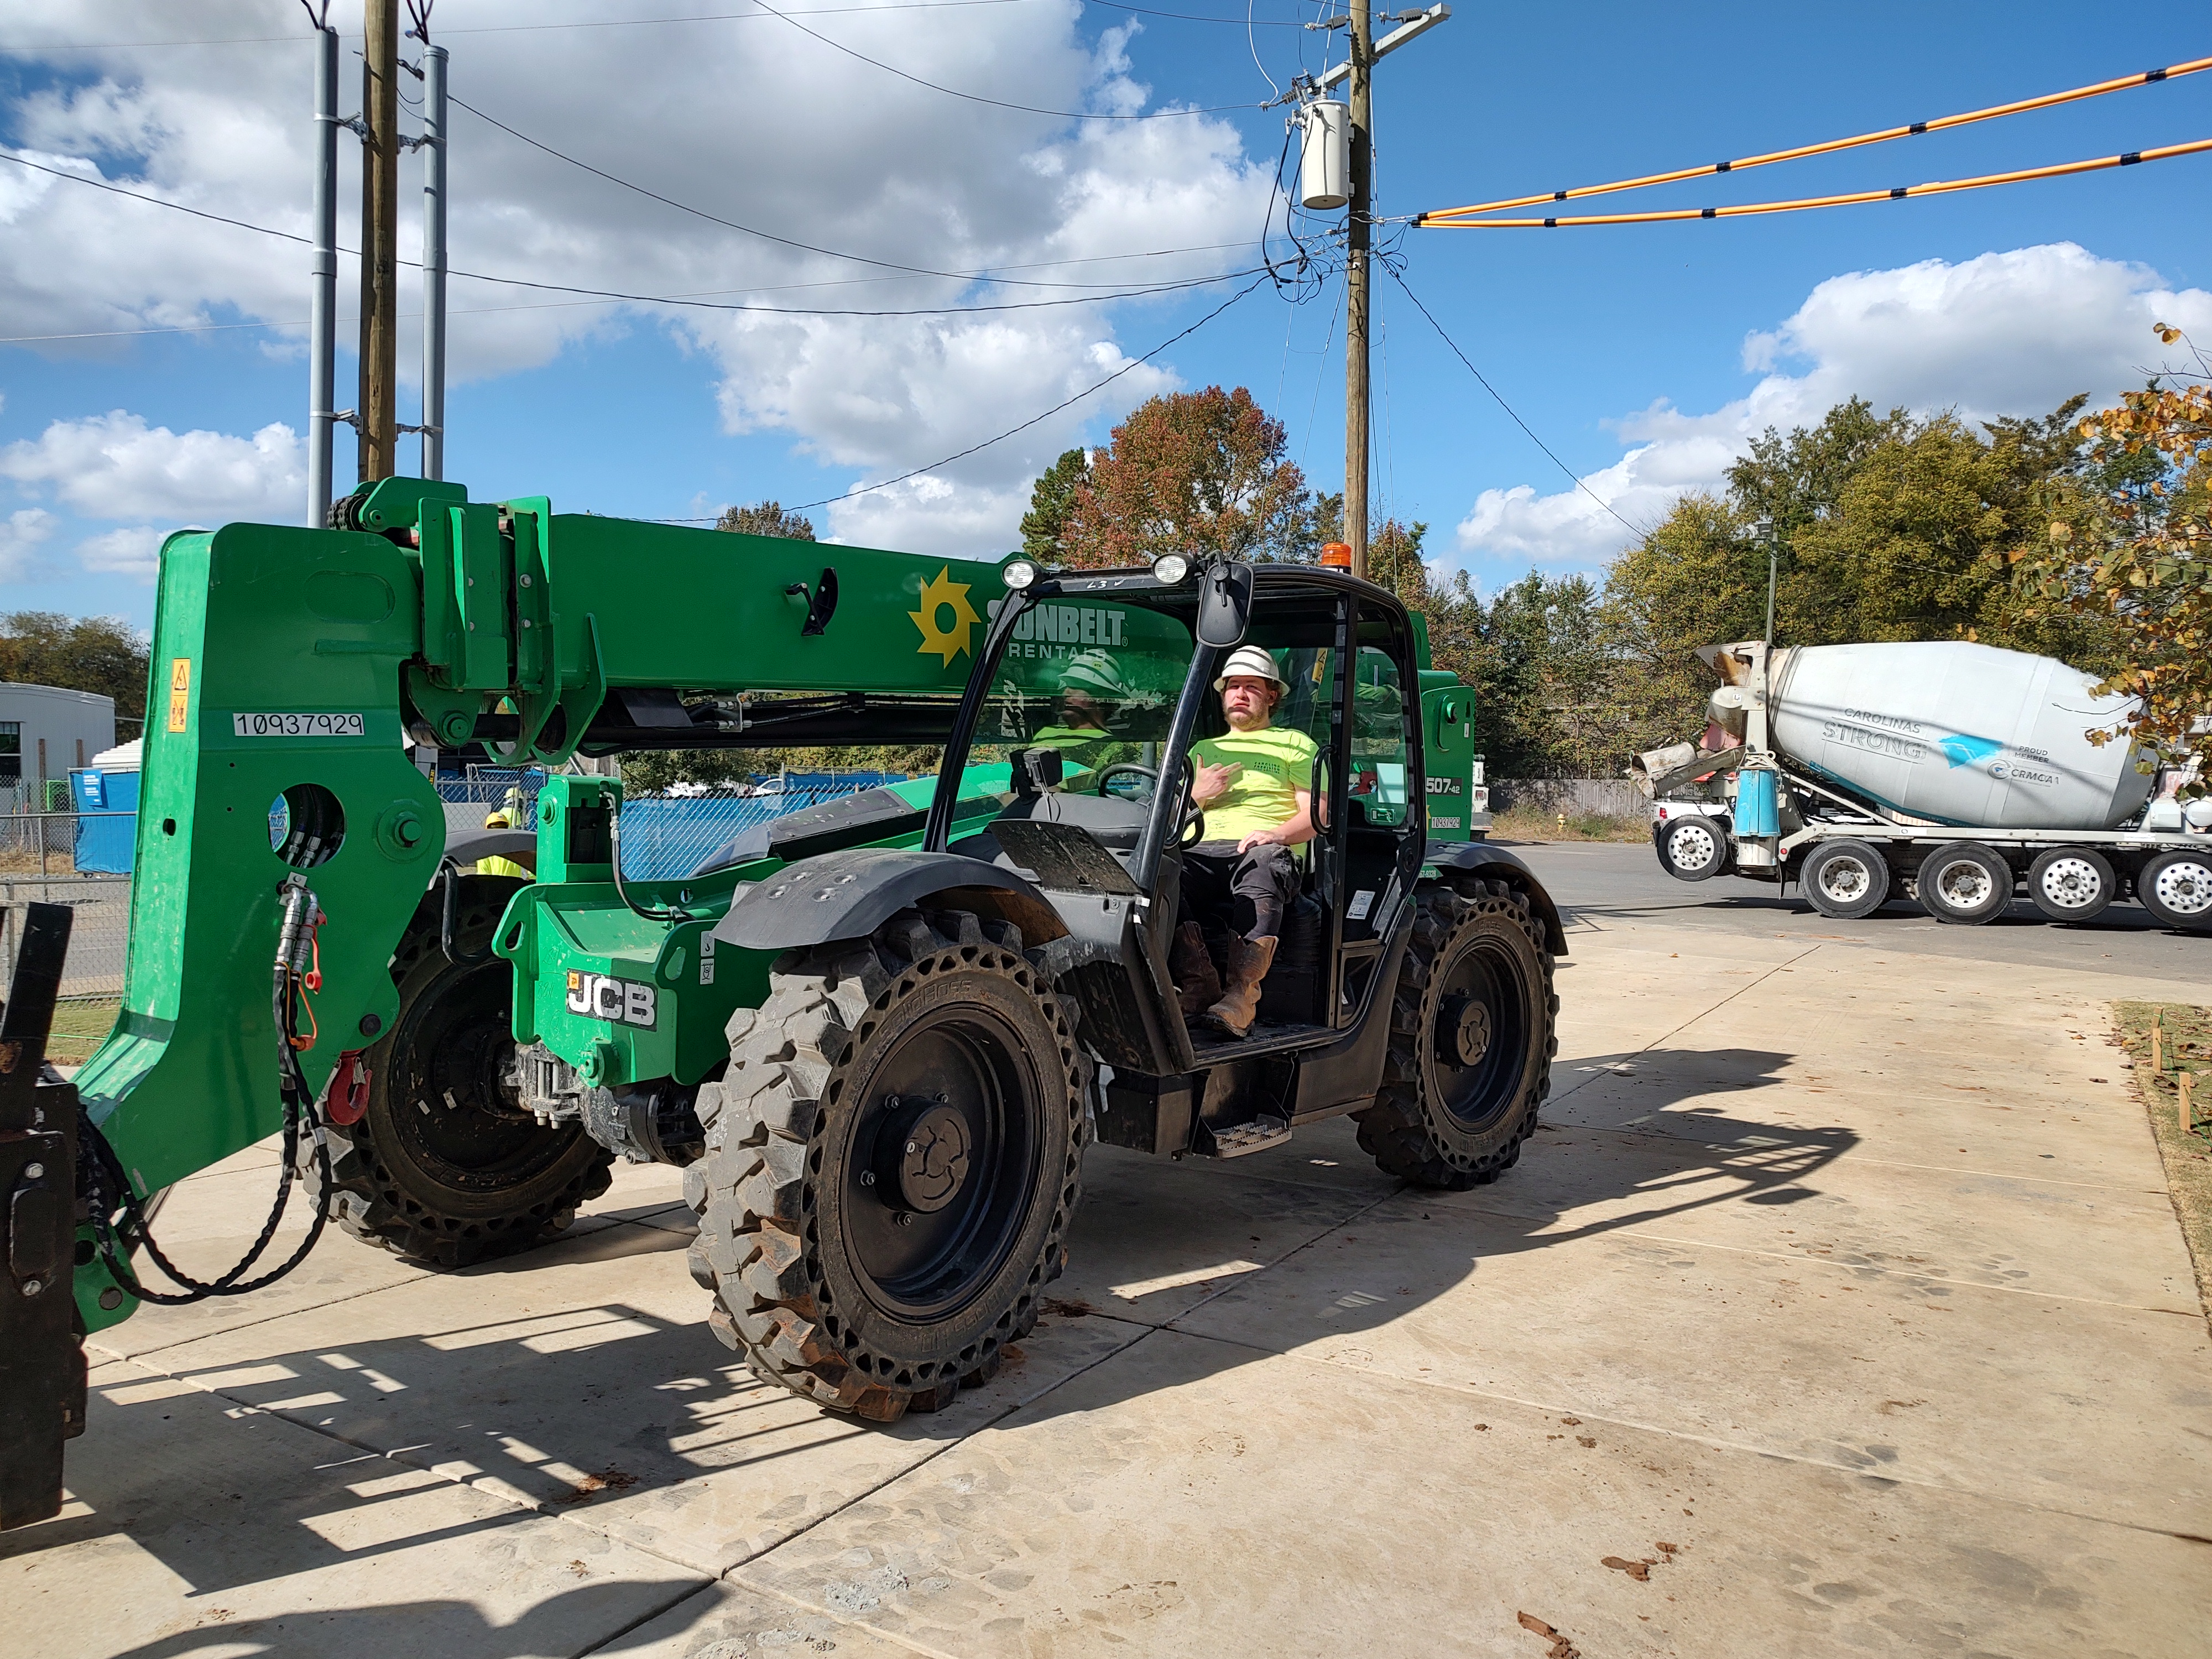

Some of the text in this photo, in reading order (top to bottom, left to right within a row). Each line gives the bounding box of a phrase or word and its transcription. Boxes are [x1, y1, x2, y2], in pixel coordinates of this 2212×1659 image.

[237, 714, 363, 734] 10937929
[1844, 708, 1922, 733] CAROLINAS
[1822, 721, 1927, 760] STRONG
[2018, 745, 2048, 756] PROUD
[2015, 752, 2049, 764] MEMBER
[1432, 817, 1459, 827] 10937929
[568, 974, 655, 1026] JCB
